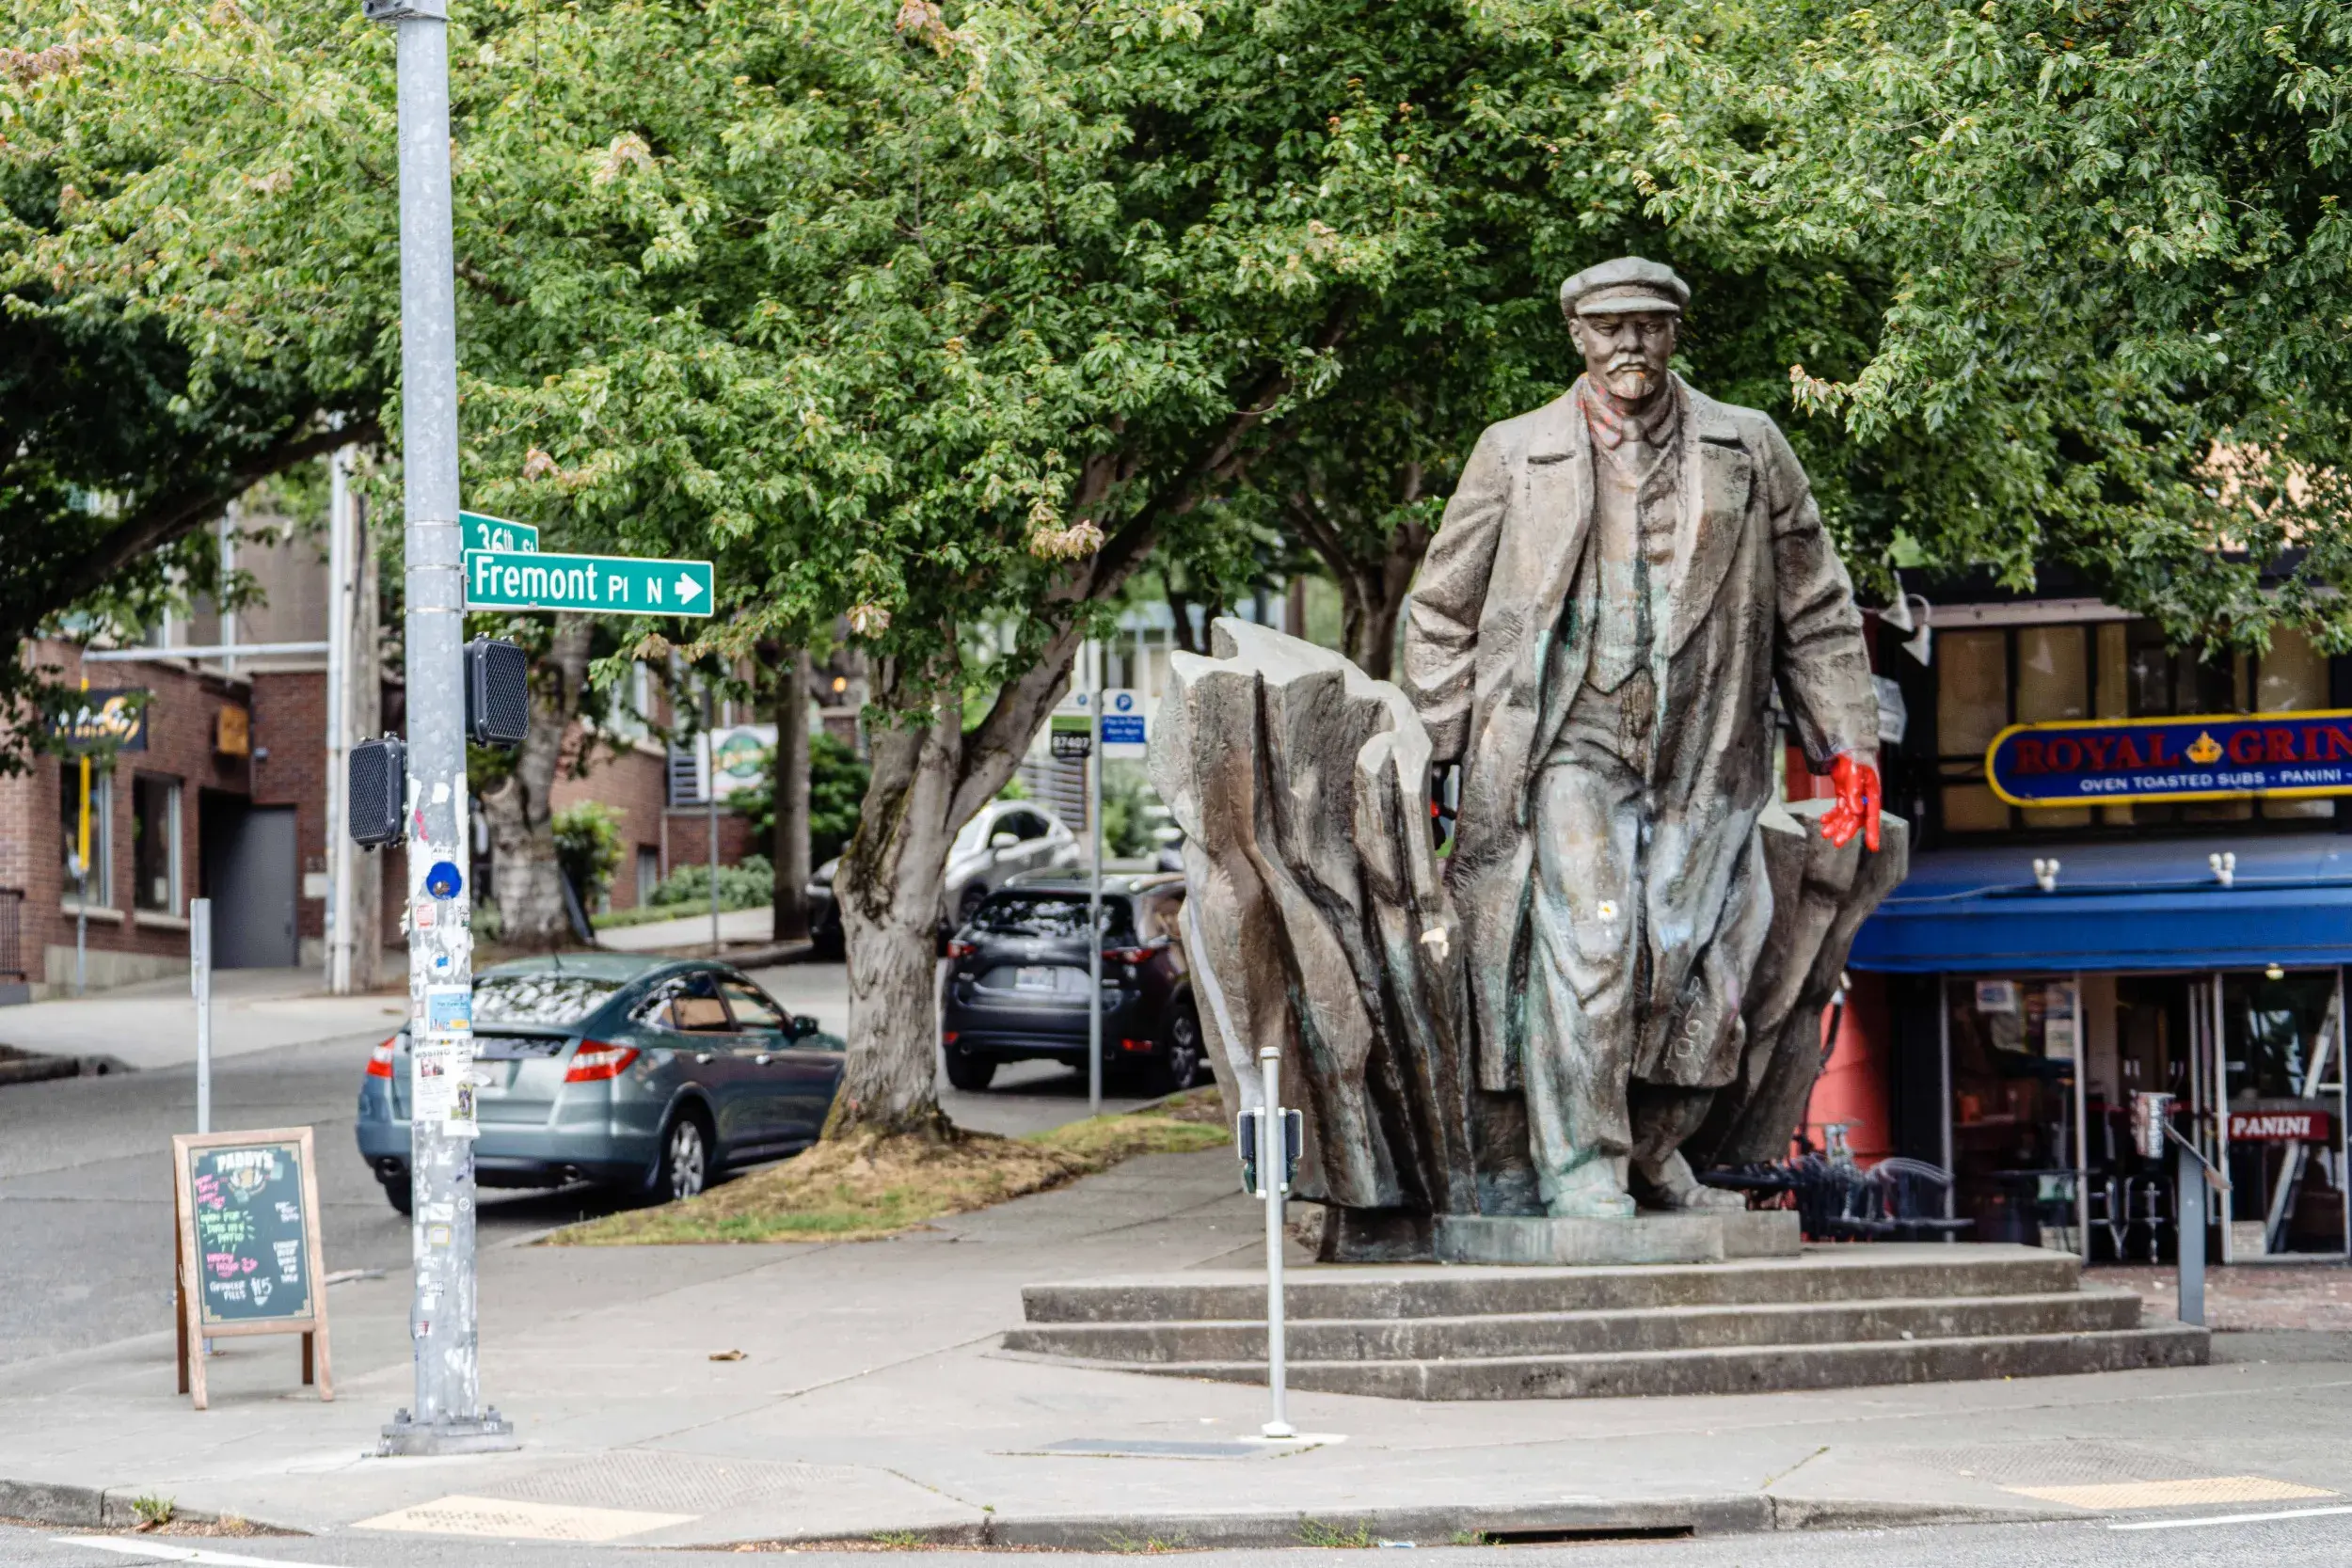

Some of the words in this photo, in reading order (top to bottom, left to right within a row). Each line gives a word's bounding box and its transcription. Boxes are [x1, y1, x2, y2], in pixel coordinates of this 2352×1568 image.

[477, 523, 514, 551] 36th
[475, 556, 598, 602] Fremont
[609, 575, 628, 602] Pl
[647, 577, 662, 604] N
[2012, 734, 2180, 774] ROYAL
[2080, 778, 2128, 792] OVEN
[2133, 774, 2213, 788] TOASTED
[2217, 771, 2265, 786] SUBS
[2280, 768, 2342, 784] PANINI
[2233, 1116, 2311, 1137] PANINI
[217, 1149, 274, 1174] PADDY'S
